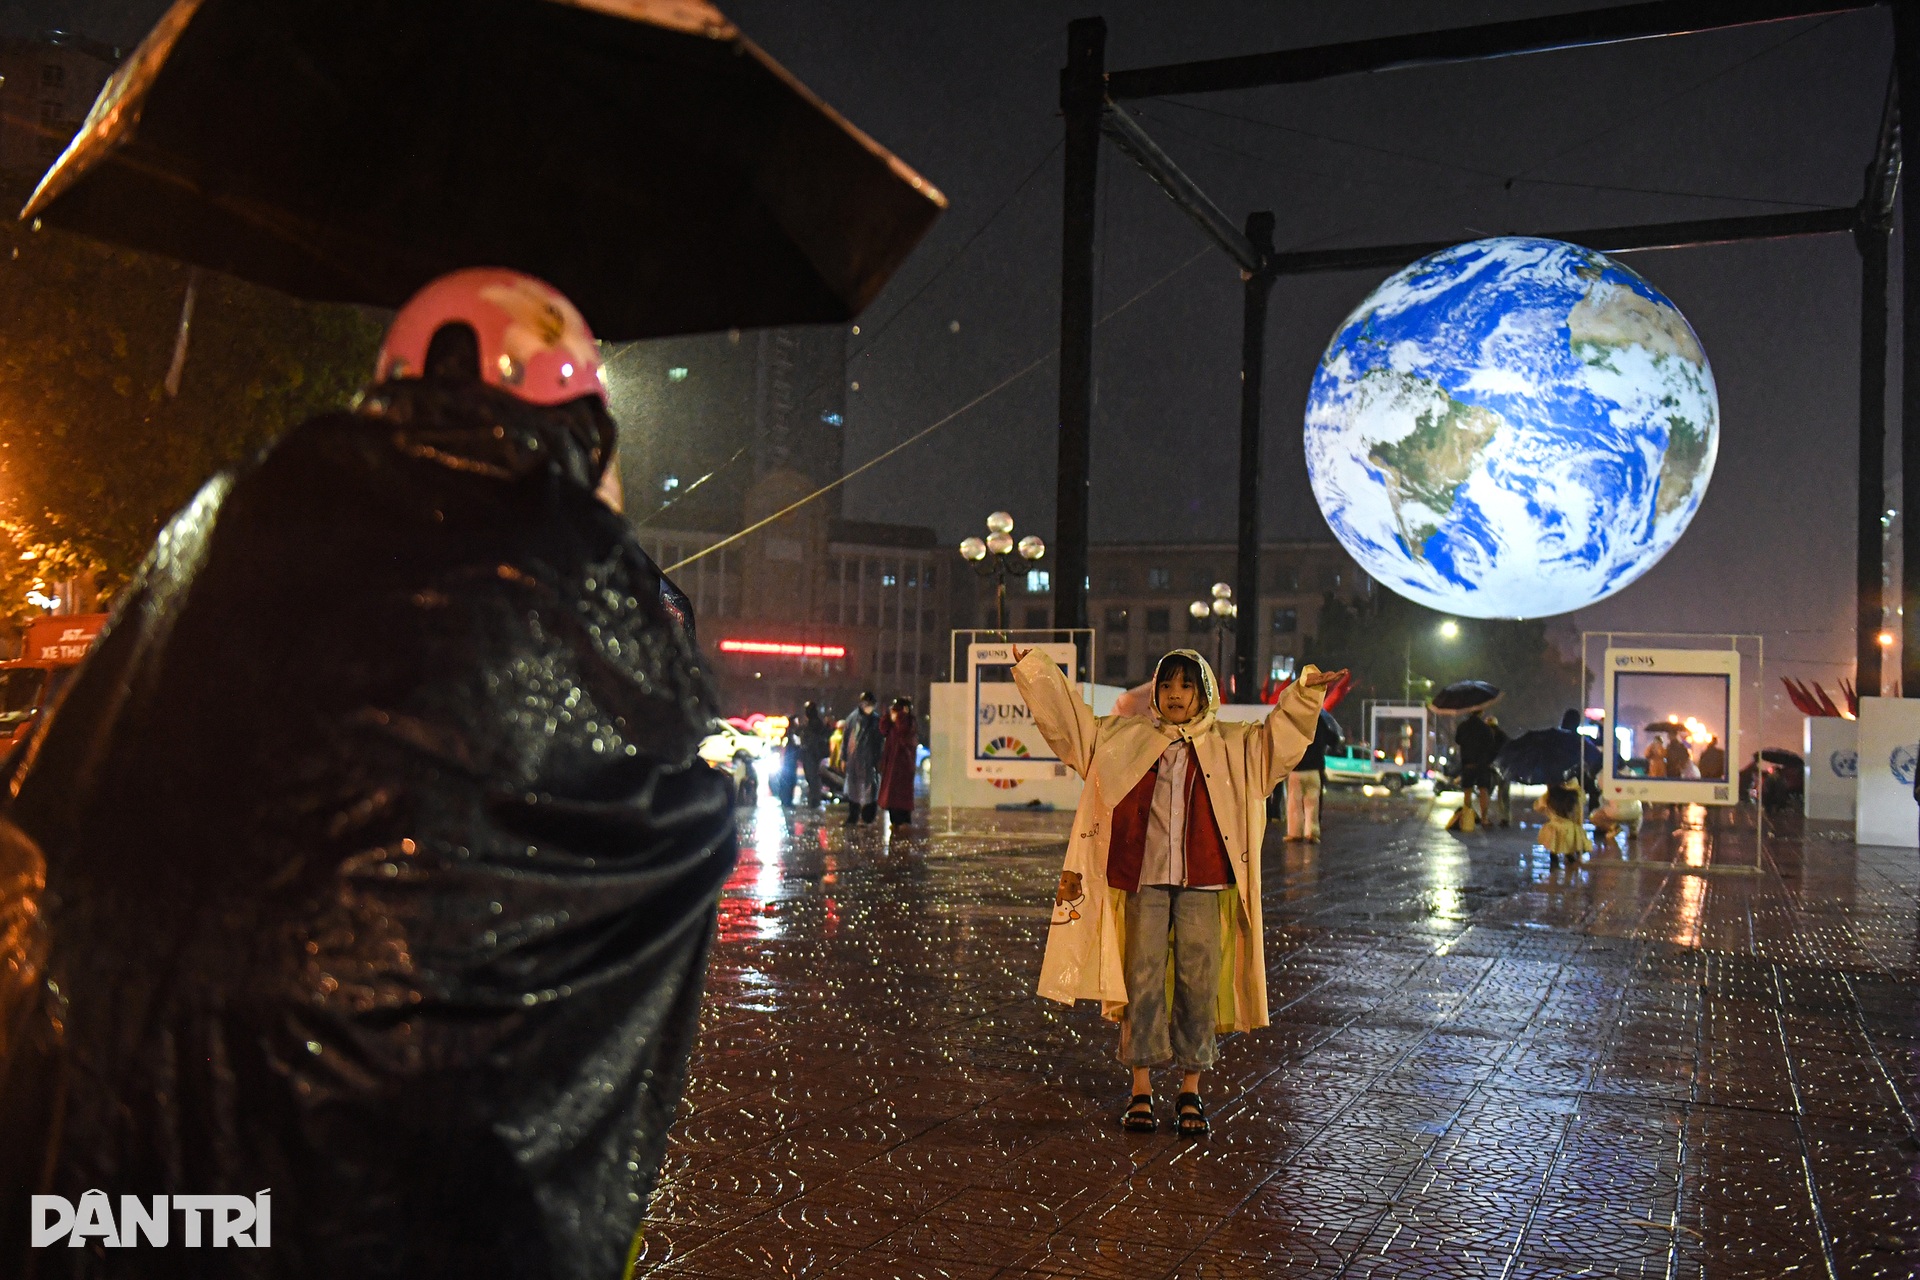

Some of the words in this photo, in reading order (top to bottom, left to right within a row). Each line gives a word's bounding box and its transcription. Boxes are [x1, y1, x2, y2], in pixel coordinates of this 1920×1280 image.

[41, 646, 58, 659] XE
[988, 650, 1008, 659] UNIS
[1630, 656, 1655, 666] UNIS
[998, 704, 1036, 722] UNI
